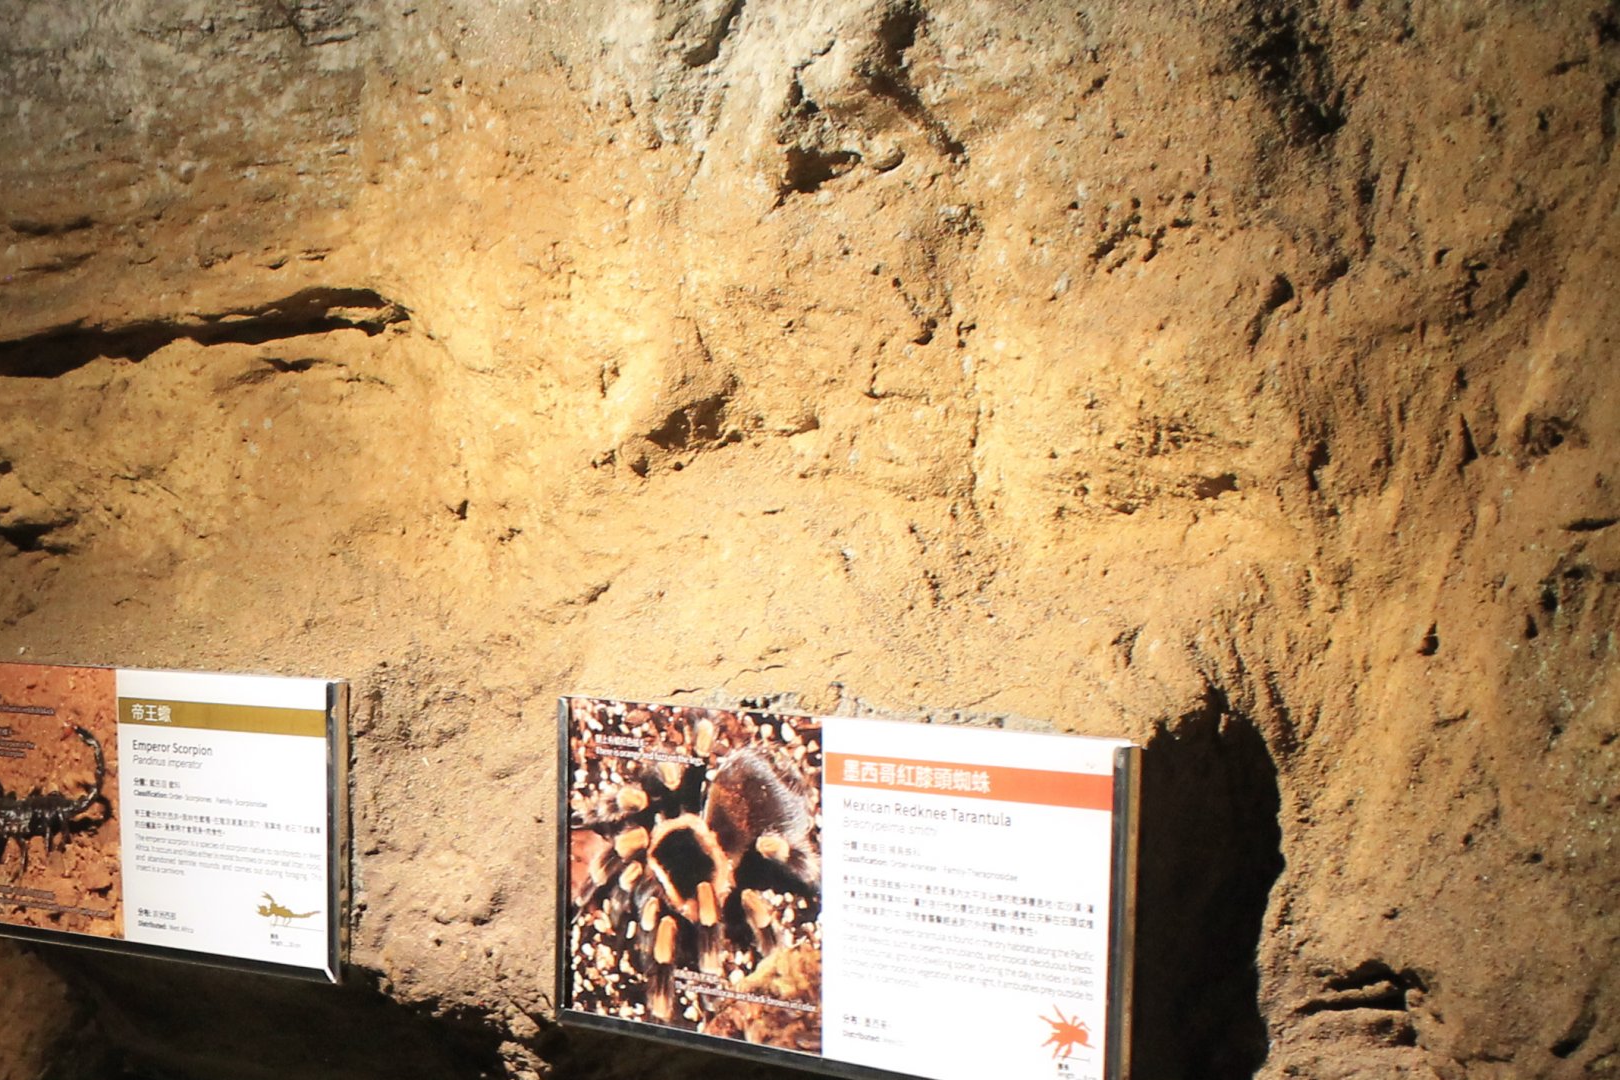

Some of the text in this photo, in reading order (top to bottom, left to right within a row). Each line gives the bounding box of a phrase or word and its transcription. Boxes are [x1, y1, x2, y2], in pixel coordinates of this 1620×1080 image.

[132, 740, 213, 757] Emperor Scorpion
[843, 759, 991, 794] 墨西哥紅膝頭蜘蛛
[843, 798, 1012, 828] Mexican Redknee Tarantula
